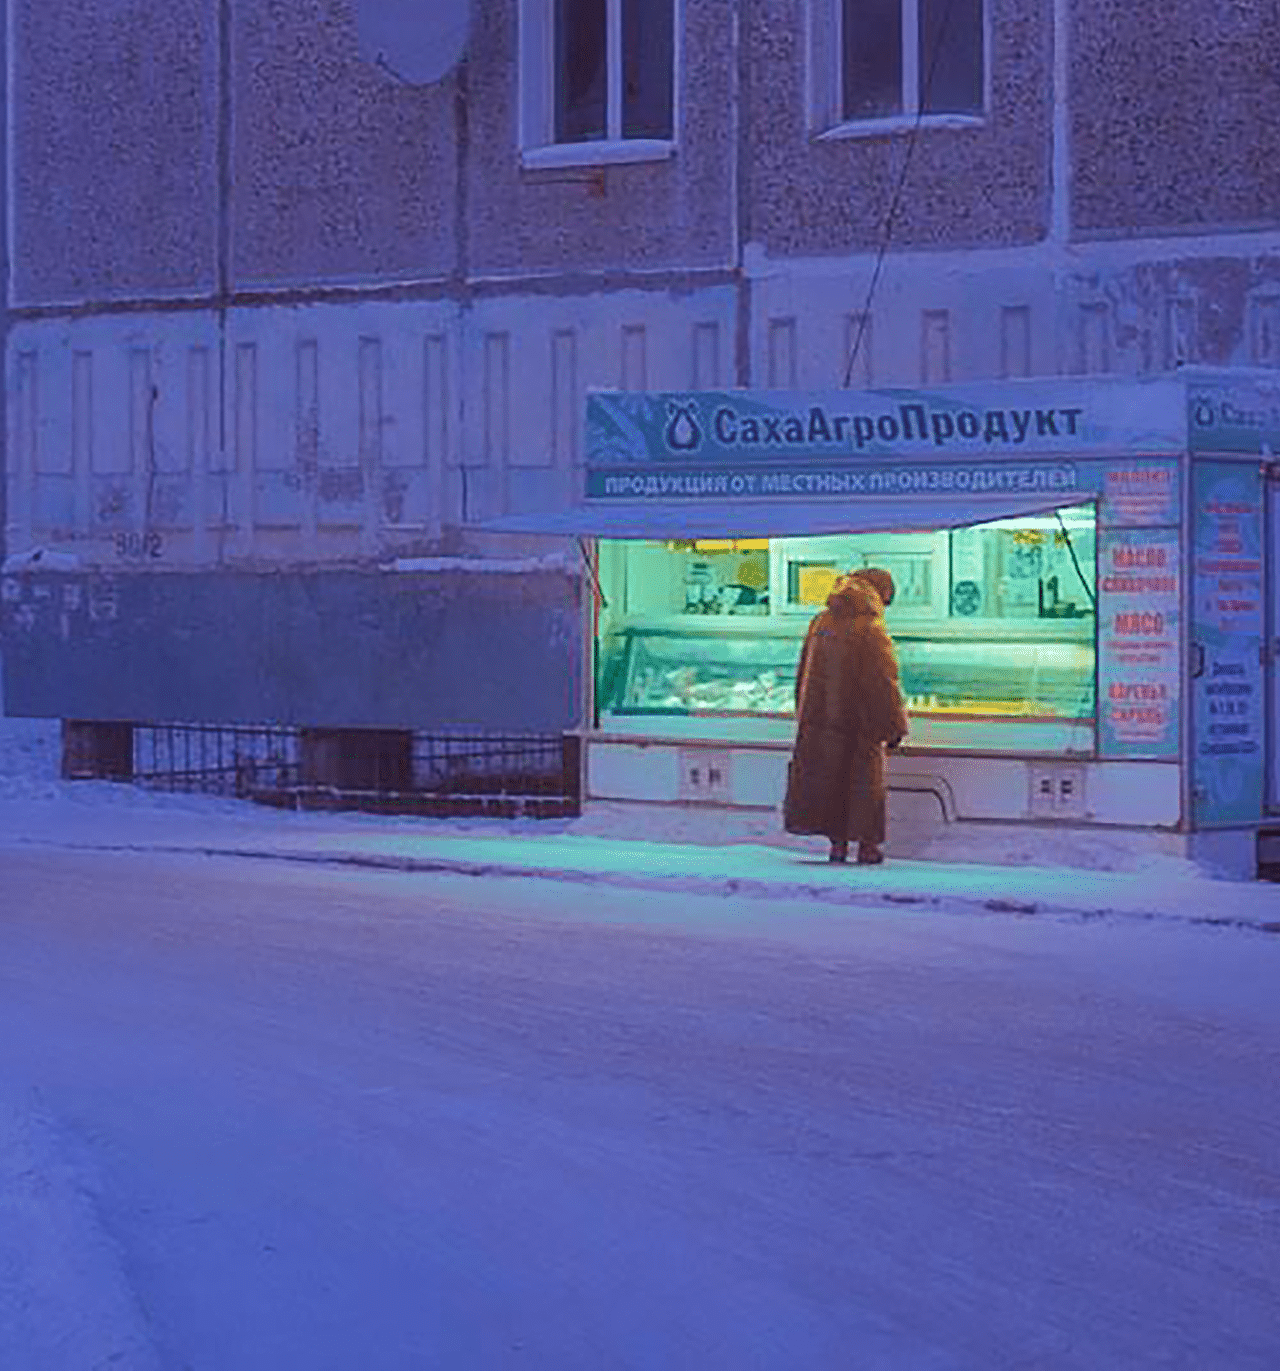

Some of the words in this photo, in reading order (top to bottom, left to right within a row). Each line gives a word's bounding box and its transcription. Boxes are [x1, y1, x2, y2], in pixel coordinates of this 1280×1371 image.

[715, 405, 1083, 449] СахаАгроПродукт
[605, 472, 726, 495] ПРОДУКЦИЯ
[730, 474, 756, 493] ОТ
[761, 470, 866, 492] МЕСТНЫХ
[868, 463, 1077, 491] ПРОИЗВОДИТЕЛЕЙ
[1115, 612, 1163, 635] МЯСО
